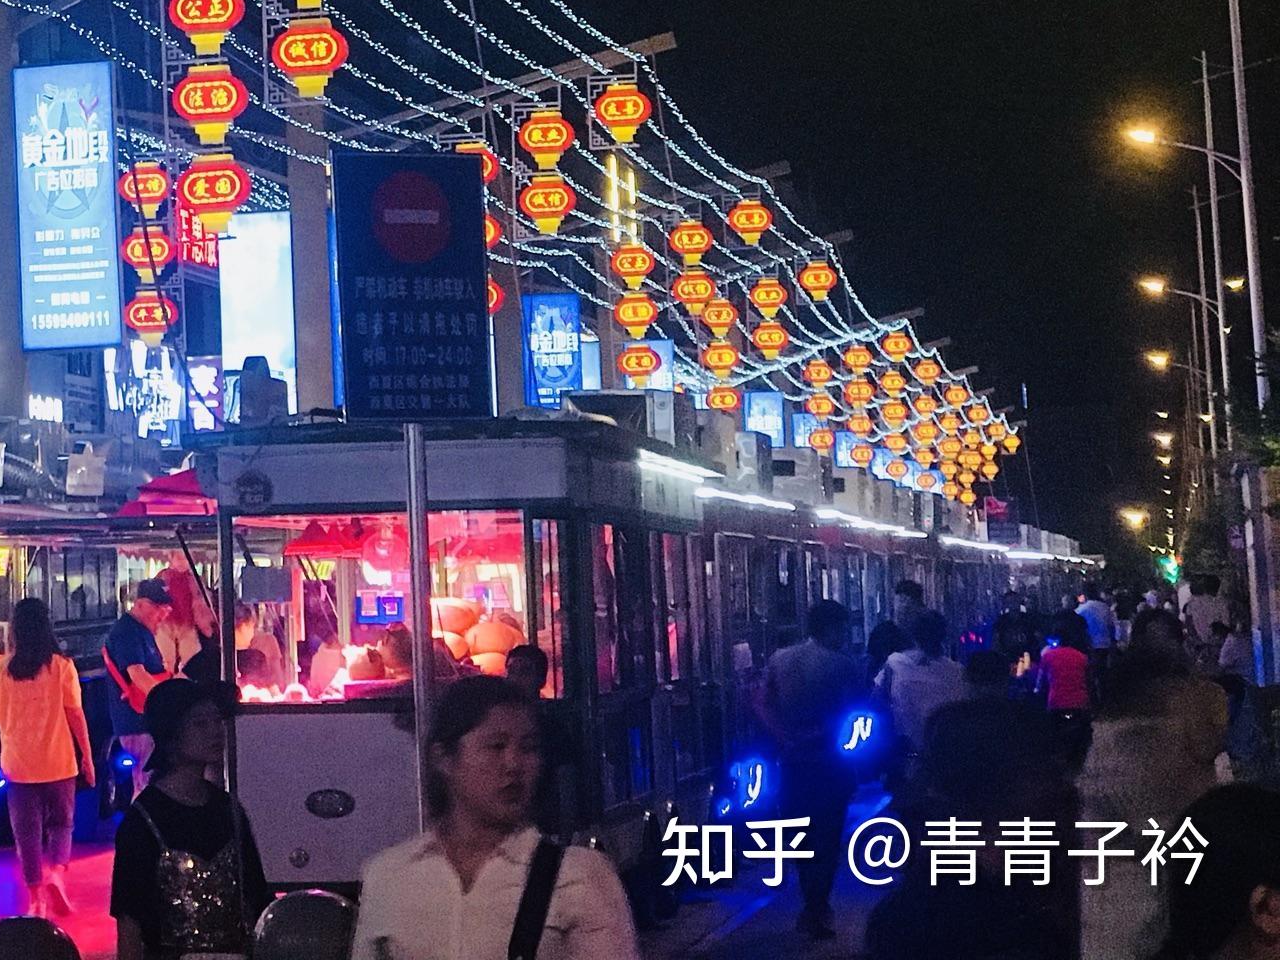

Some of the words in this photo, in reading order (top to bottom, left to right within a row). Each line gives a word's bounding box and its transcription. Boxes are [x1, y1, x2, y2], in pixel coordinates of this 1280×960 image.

[185, 0, 226, 18] 公正
[288, 41, 329, 60] 诚信
[189, 87, 228, 107] 法治
[22, 127, 109, 168] 黄金地段
